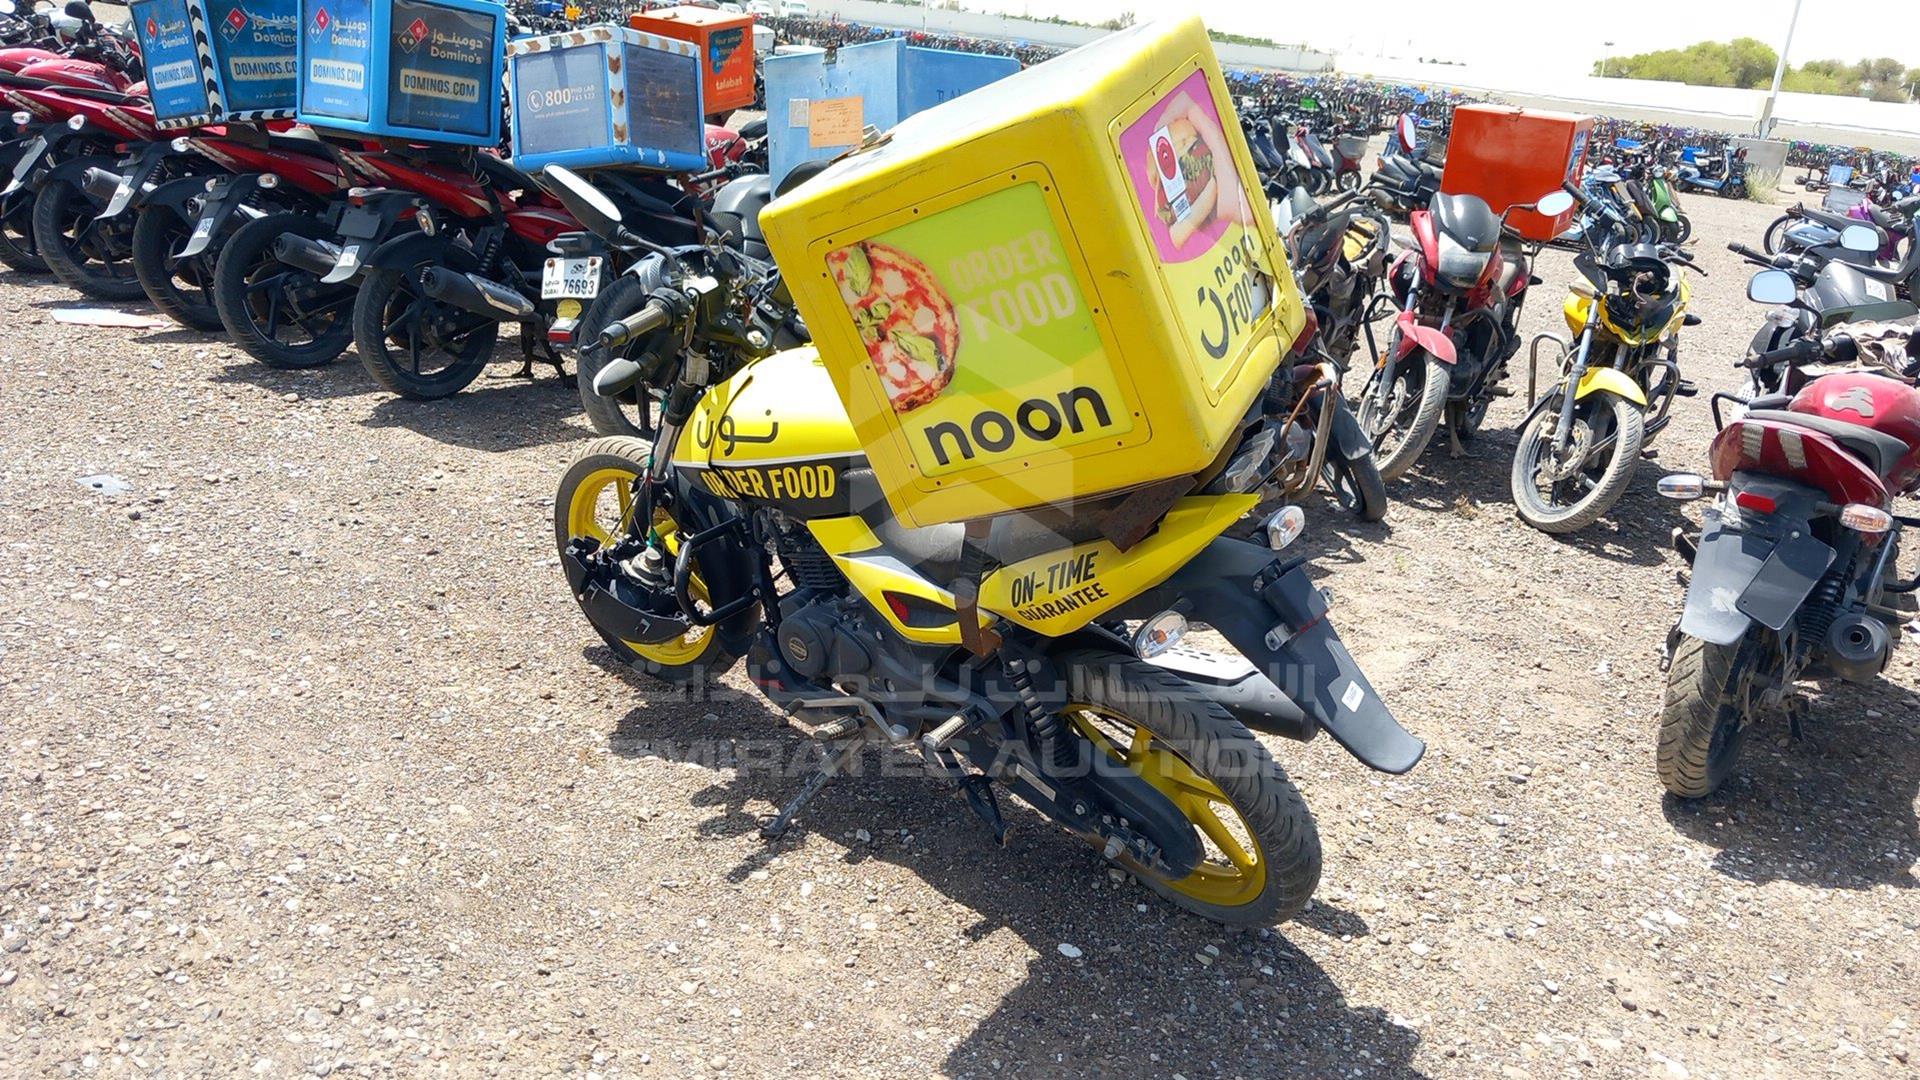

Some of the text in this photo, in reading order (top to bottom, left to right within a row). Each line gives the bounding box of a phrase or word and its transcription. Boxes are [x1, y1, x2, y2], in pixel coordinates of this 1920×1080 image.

[331, 33, 367, 49] Domino's
[430, 46, 482, 65] Domino's
[154, 63, 194, 85] DOMINOS.COM
[233, 60, 297, 76] DOMINOS.CO
[313, 64, 362, 84] DOMINOS.COM
[404, 74, 475, 98] DOMINOS.COM
[715, 75, 743, 91] talabat
[545, 88, 571, 107] 800
[952, 229, 1059, 293] ORDER
[562, 279, 595, 295] 76693
[967, 272, 1077, 342] FOOD
[923, 386, 1113, 466] noon
[701, 464, 837, 499] ORDER FOOD
[1011, 550, 1100, 609] ON-TIME
[1017, 582, 1110, 622] GUARANTEE
